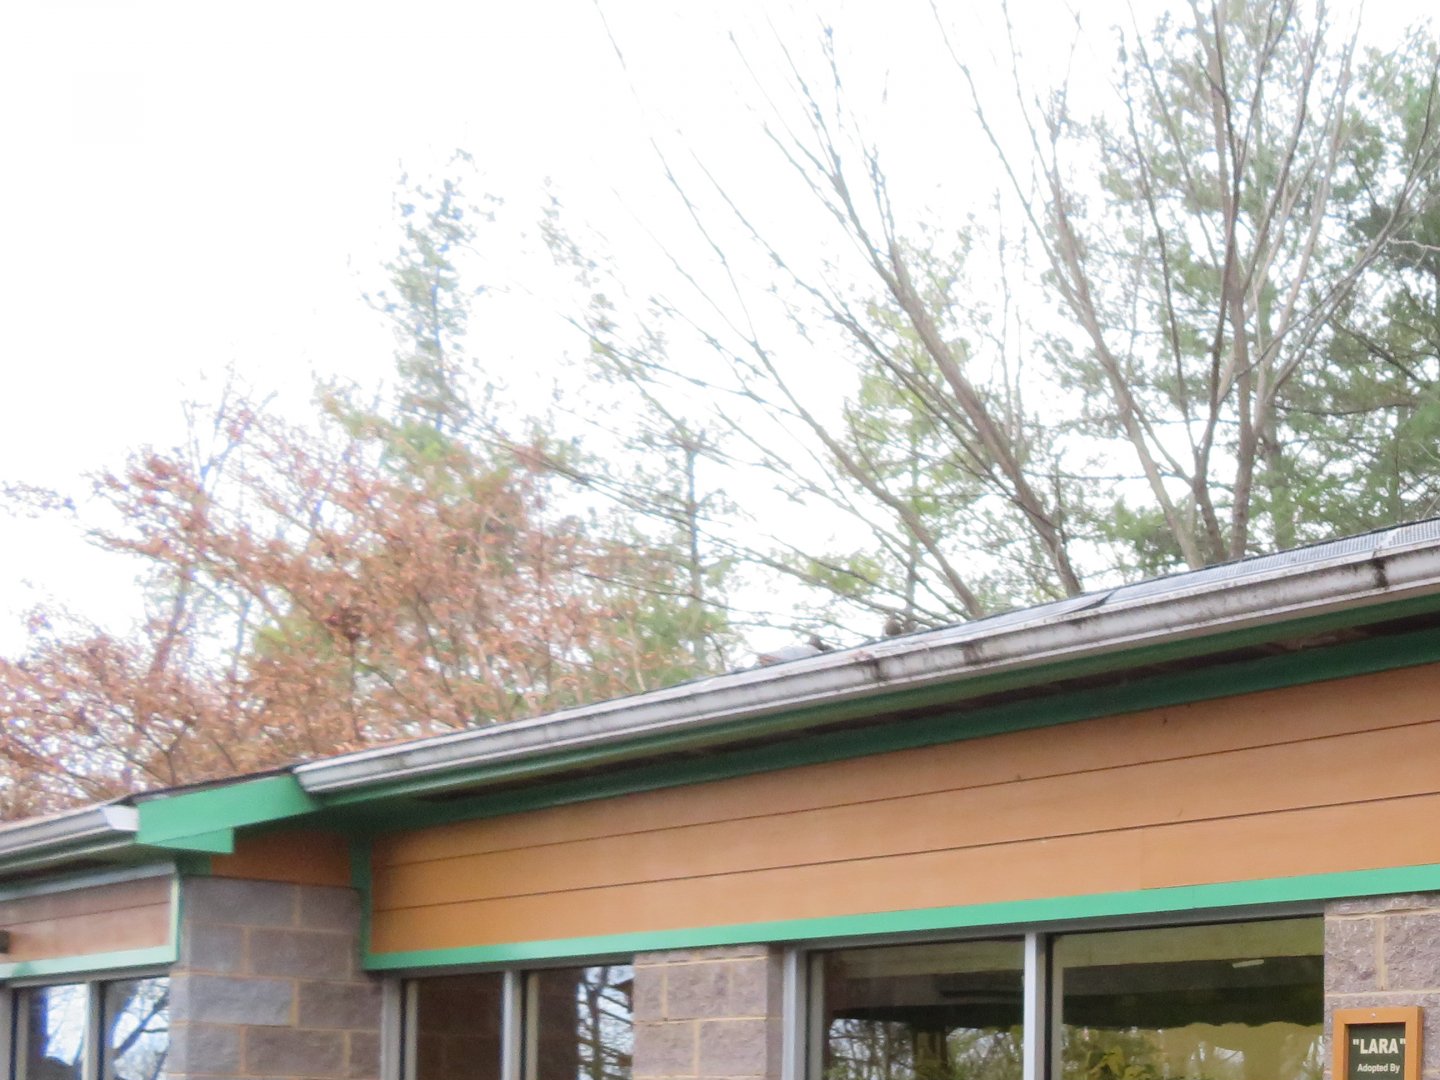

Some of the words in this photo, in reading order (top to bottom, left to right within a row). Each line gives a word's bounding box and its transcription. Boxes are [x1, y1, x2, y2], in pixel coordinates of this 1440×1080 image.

[1352, 1038, 1406, 1054] "LARA"
[1357, 1063, 1388, 1073] Adopted
[1390, 1063, 1400, 1073] By
